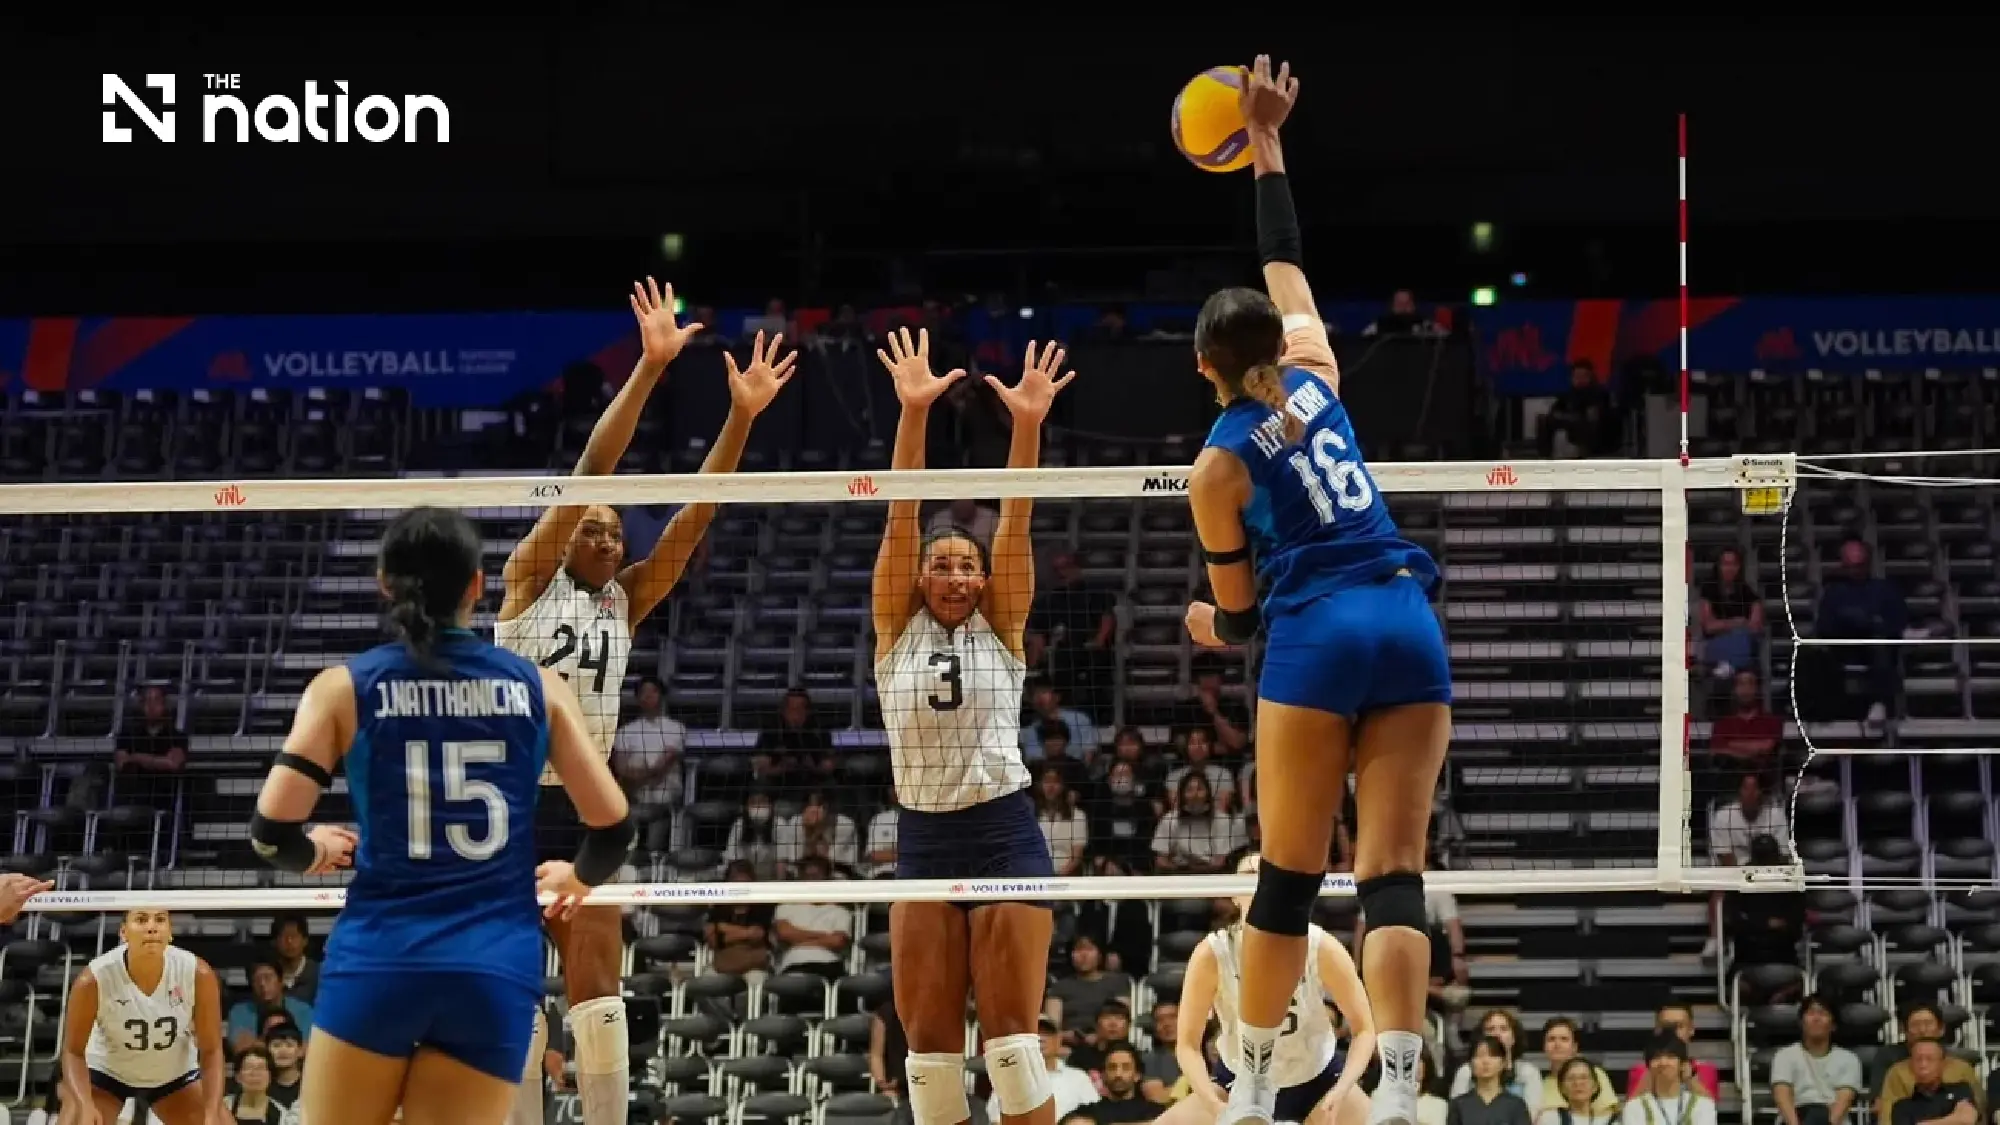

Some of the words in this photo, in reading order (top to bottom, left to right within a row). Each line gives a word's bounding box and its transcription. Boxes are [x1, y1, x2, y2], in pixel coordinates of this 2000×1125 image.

[264, 350, 455, 377] VOLLEYBALL
[529, 484, 565, 498] ACN
[1289, 427, 1373, 523] 16
[539, 623, 609, 693] 24
[374, 679, 531, 719] J.NATTHANICHA
[928, 652, 963, 711] 3
[405, 739, 509, 861] 15
[28, 896, 91, 904] OLLEYBALL
[124, 1016, 178, 1051] 33
